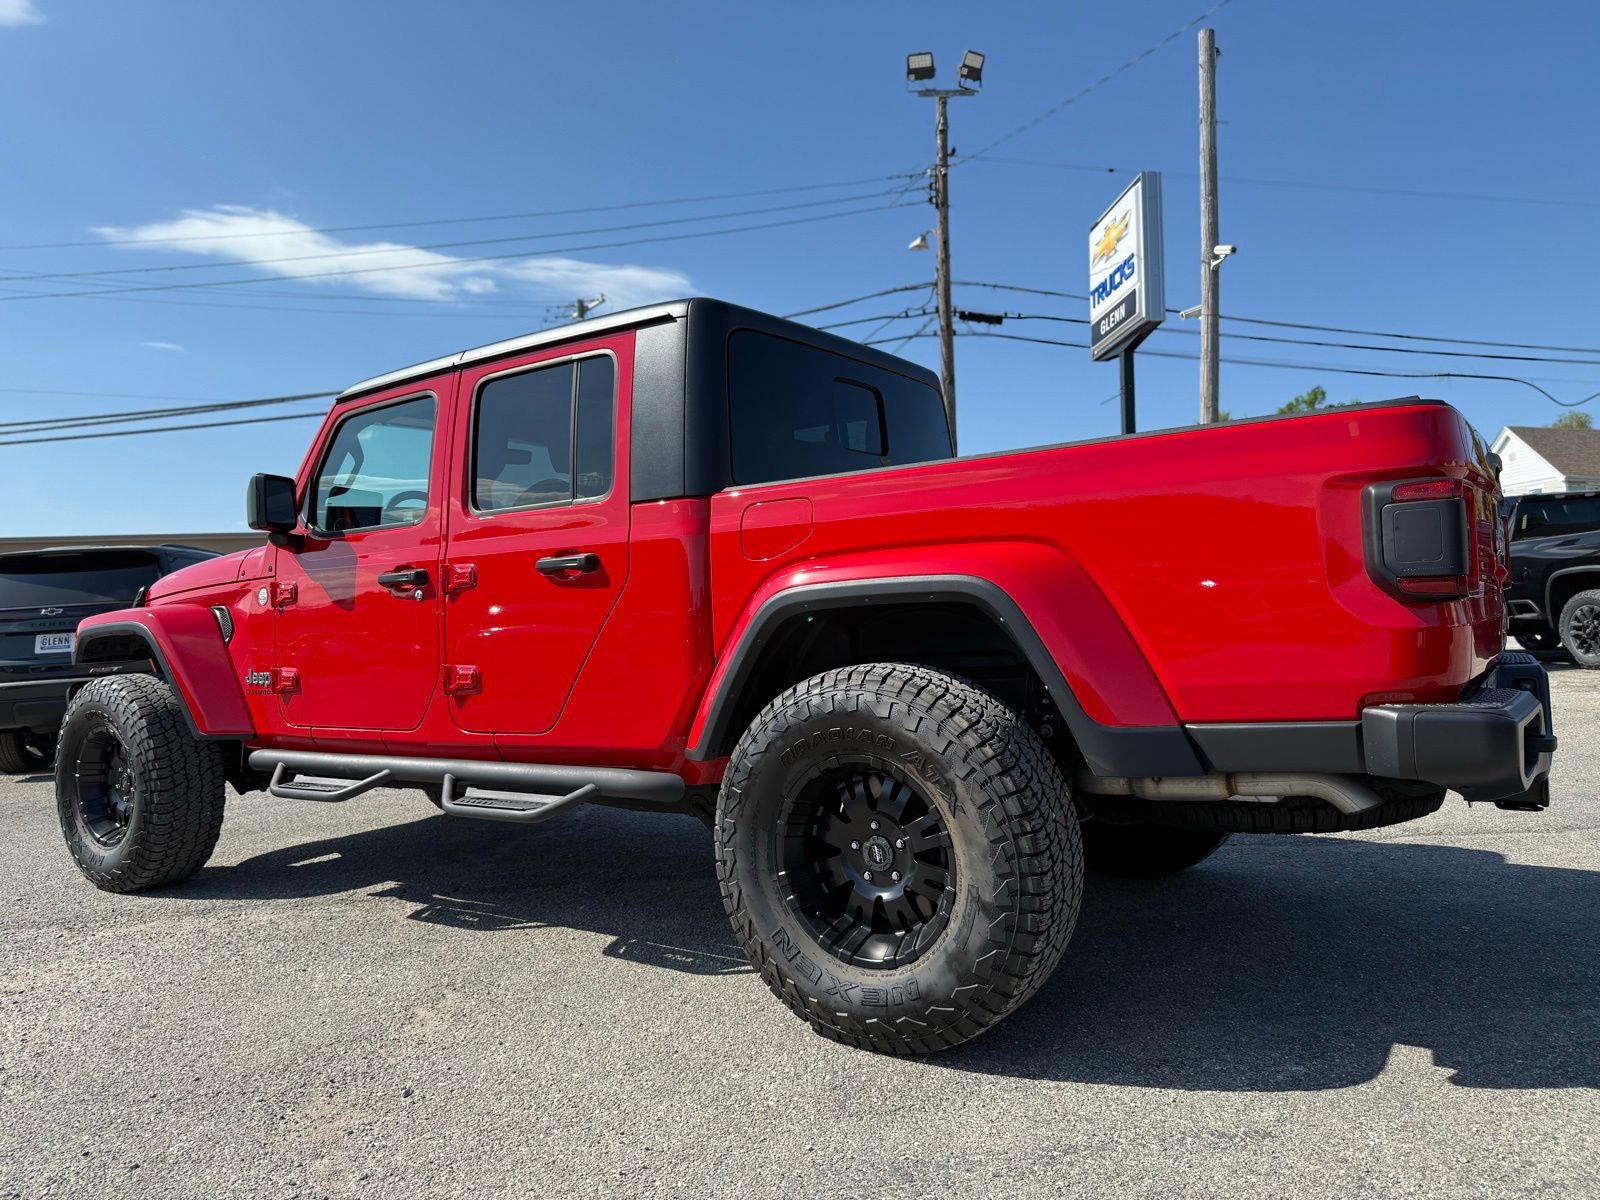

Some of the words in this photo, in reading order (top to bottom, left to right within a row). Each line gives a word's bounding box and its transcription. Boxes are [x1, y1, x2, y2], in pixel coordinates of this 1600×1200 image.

[1090, 253, 1135, 309] TRUCKS
[1100, 303, 1126, 335] GLENN
[41, 636, 70, 646] GLENN
[245, 668, 271, 687] Jeep
[780, 727, 896, 768] ROADIAN
[770, 926, 921, 1008] NEXEN
